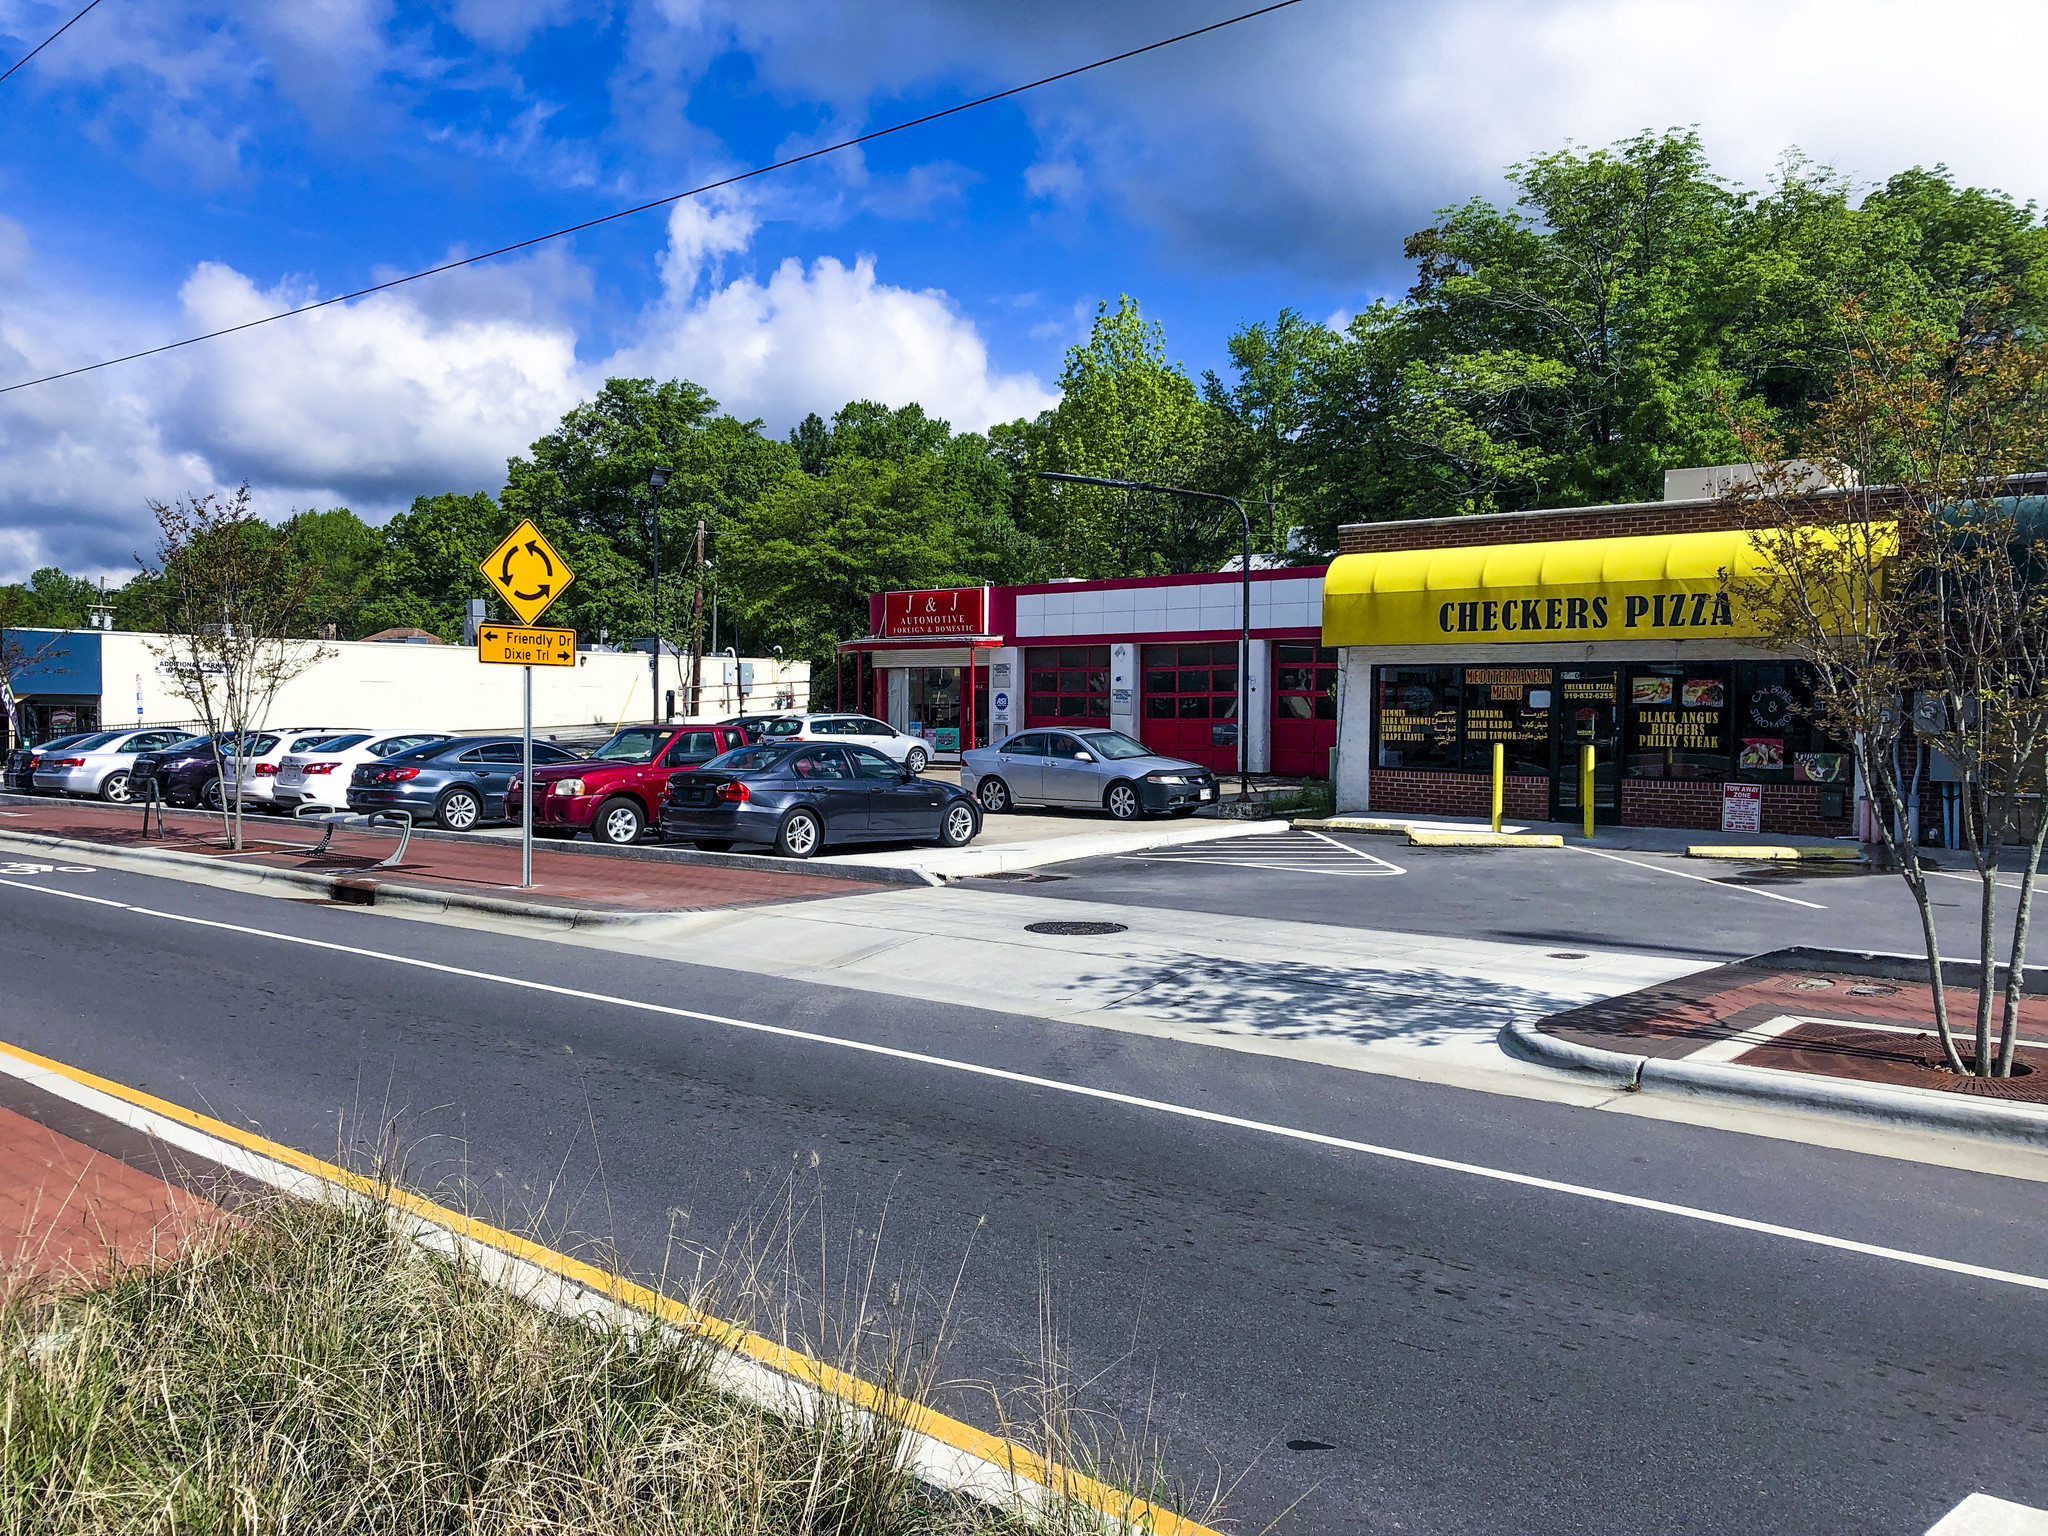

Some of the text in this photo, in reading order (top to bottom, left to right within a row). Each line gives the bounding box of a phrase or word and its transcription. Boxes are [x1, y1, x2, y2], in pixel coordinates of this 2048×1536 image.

[906, 592, 958, 613] J & J
[900, 614, 965, 625] AUTOMOTIVE
[1439, 592, 1732, 634] CHECKERS PIZZA
[507, 632, 571, 648] Friendly Dr
[505, 648, 549, 660] Dixie Trl
[1466, 669, 1552, 684] MEDITERRANEAN
[1491, 685, 1523, 700] MENU
[1768, 701, 1778, 713] &
[1468, 710, 1503, 718] SHAWARMA
[1639, 712, 1718, 724] BLACK ANGUS
[1750, 708, 1797, 728] STROMBOL
[1651, 724, 1705, 735] BURGERS
[1639, 735, 1718, 748] PHILLY STEAK
